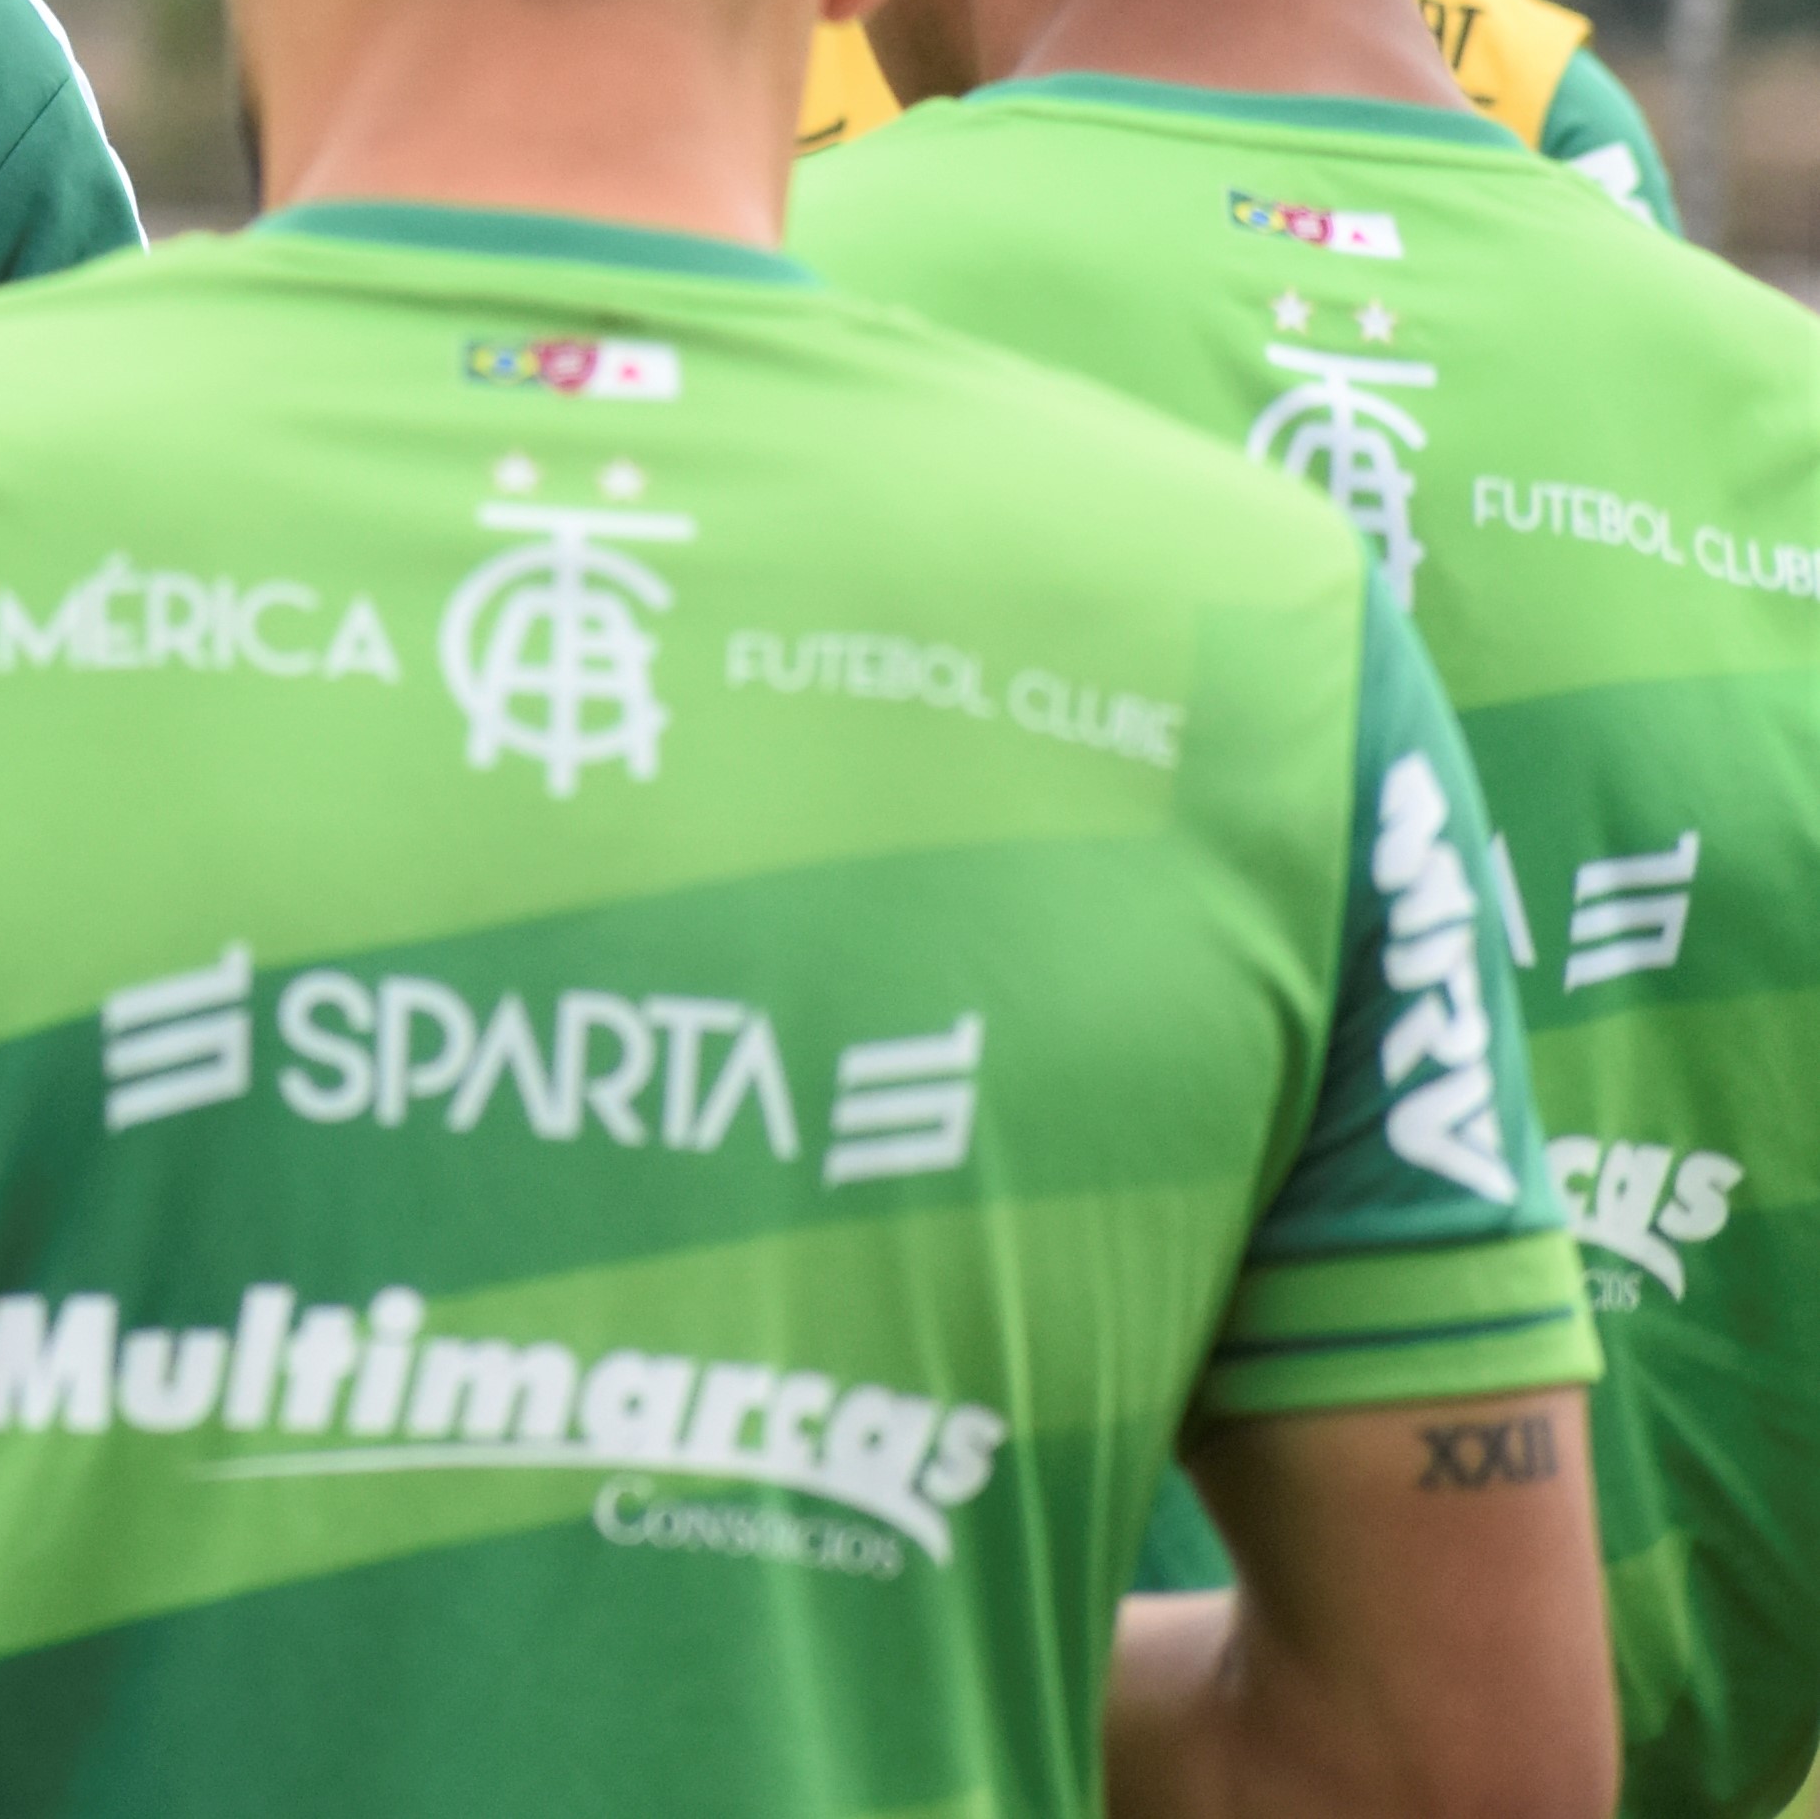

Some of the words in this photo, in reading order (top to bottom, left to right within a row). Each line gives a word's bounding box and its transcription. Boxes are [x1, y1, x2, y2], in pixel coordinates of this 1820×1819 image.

[1470, 474, 1685, 566] FUTEBOL
[724, 627, 995, 720] FUTEBOL
[1006, 666, 1187, 770] CLUBE
[1372, 748, 1521, 1206] MRV
[276, 970, 801, 1165] SPARTA
[1421, 1418, 1557, 1490] XXII
